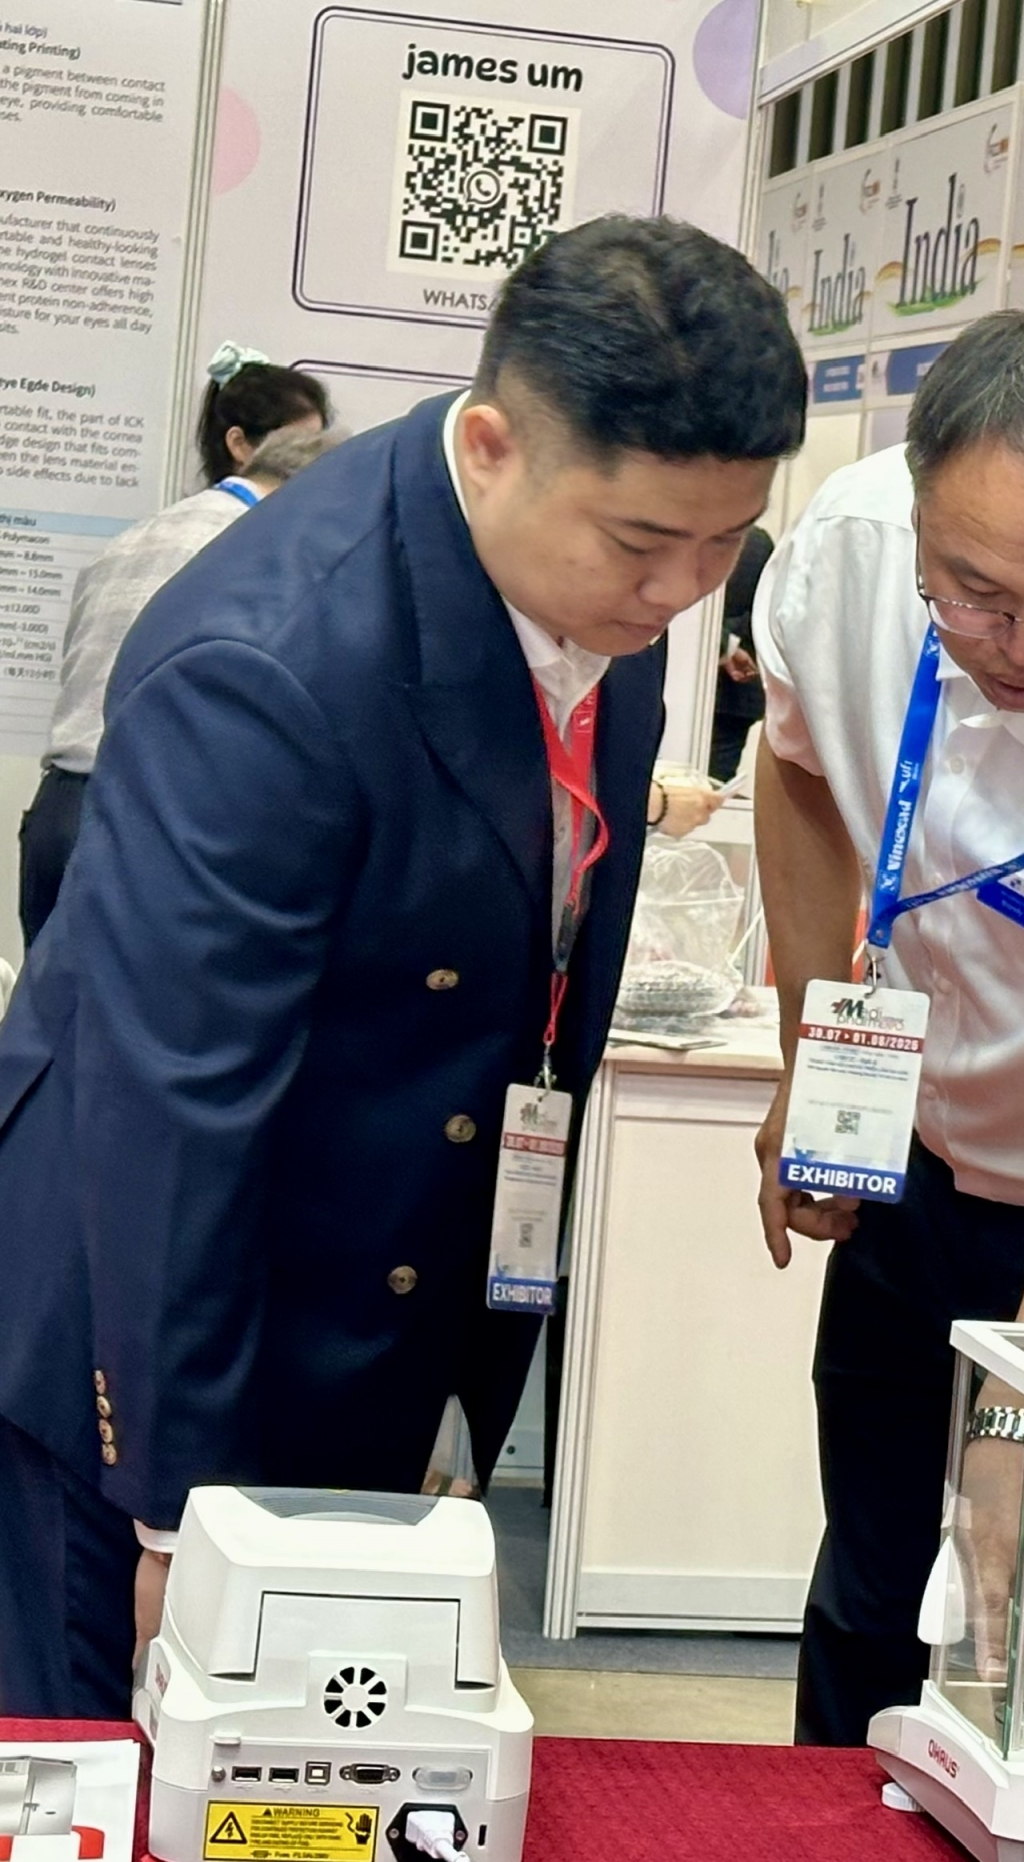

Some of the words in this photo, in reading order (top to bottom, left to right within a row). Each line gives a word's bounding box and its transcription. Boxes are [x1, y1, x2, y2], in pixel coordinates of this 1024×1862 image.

[29, 41, 81, 60] Printing)
[13, 65, 63, 80] pigment
[67, 69, 118, 86] between
[121, 77, 166, 92] contact
[402, 43, 518, 84] james
[527, 62, 583, 93] um
[22, 82, 71, 97] pigment
[75, 85, 103, 100] from
[106, 92, 150, 108] coming
[152, 95, 164, 107] in
[30, 99, 86, 117] providing
[91, 105, 163, 122] comfortable
[36, 191, 117, 212] Permeability)
[56, 219, 80, 232] that
[84, 224, 160, 243] continuously
[895, 172, 979, 308] India
[39, 234, 63, 247] and
[68, 236, 158, 260] healthy-looking
[15, 246, 67, 263] hydrogel
[72, 252, 115, 267] contact
[120, 257, 157, 272] lenses
[44, 265, 69, 278] with
[71, 267, 130, 285] innovative
[808, 233, 866, 333] India
[18, 293, 60, 307] protein
[51, 282, 88, 294] center
[91, 285, 125, 299] offers
[129, 288, 154, 304] high
[34, 308, 50, 321] for
[53, 314, 80, 327] your
[83, 317, 110, 330] eyes
[112, 317, 127, 330] all
[130, 319, 153, 335] day
[20, 378, 49, 393] Egde
[51, 381, 96, 398] Design)
[37, 406, 52, 420] fit,
[57, 409, 76, 421] the
[80, 413, 104, 425] part
[108, 413, 121, 425] of
[4, 421, 48, 434] contact
[51, 424, 77, 437] with
[80, 427, 100, 439] the
[102, 430, 143, 443] cornea
[22, 436, 61, 453] design
[64, 440, 88, 453] that
[90, 441, 109, 455] fits
[20, 452, 40, 464] the
[43, 453, 67, 467] lens
[70, 457, 118, 471] material
[6, 465, 30, 478] side
[33, 467, 72, 482] effects
[74, 472, 97, 485] due
[100, 475, 112, 486] to
[115, 475, 138, 488] lack
[808, 1026, 841, 1041] 30.07
[787, 1163, 897, 1194] EXHIBITOR
[492, 1282, 552, 1306] EXHIBITOR
[273, 1807, 320, 1818] WARNING
